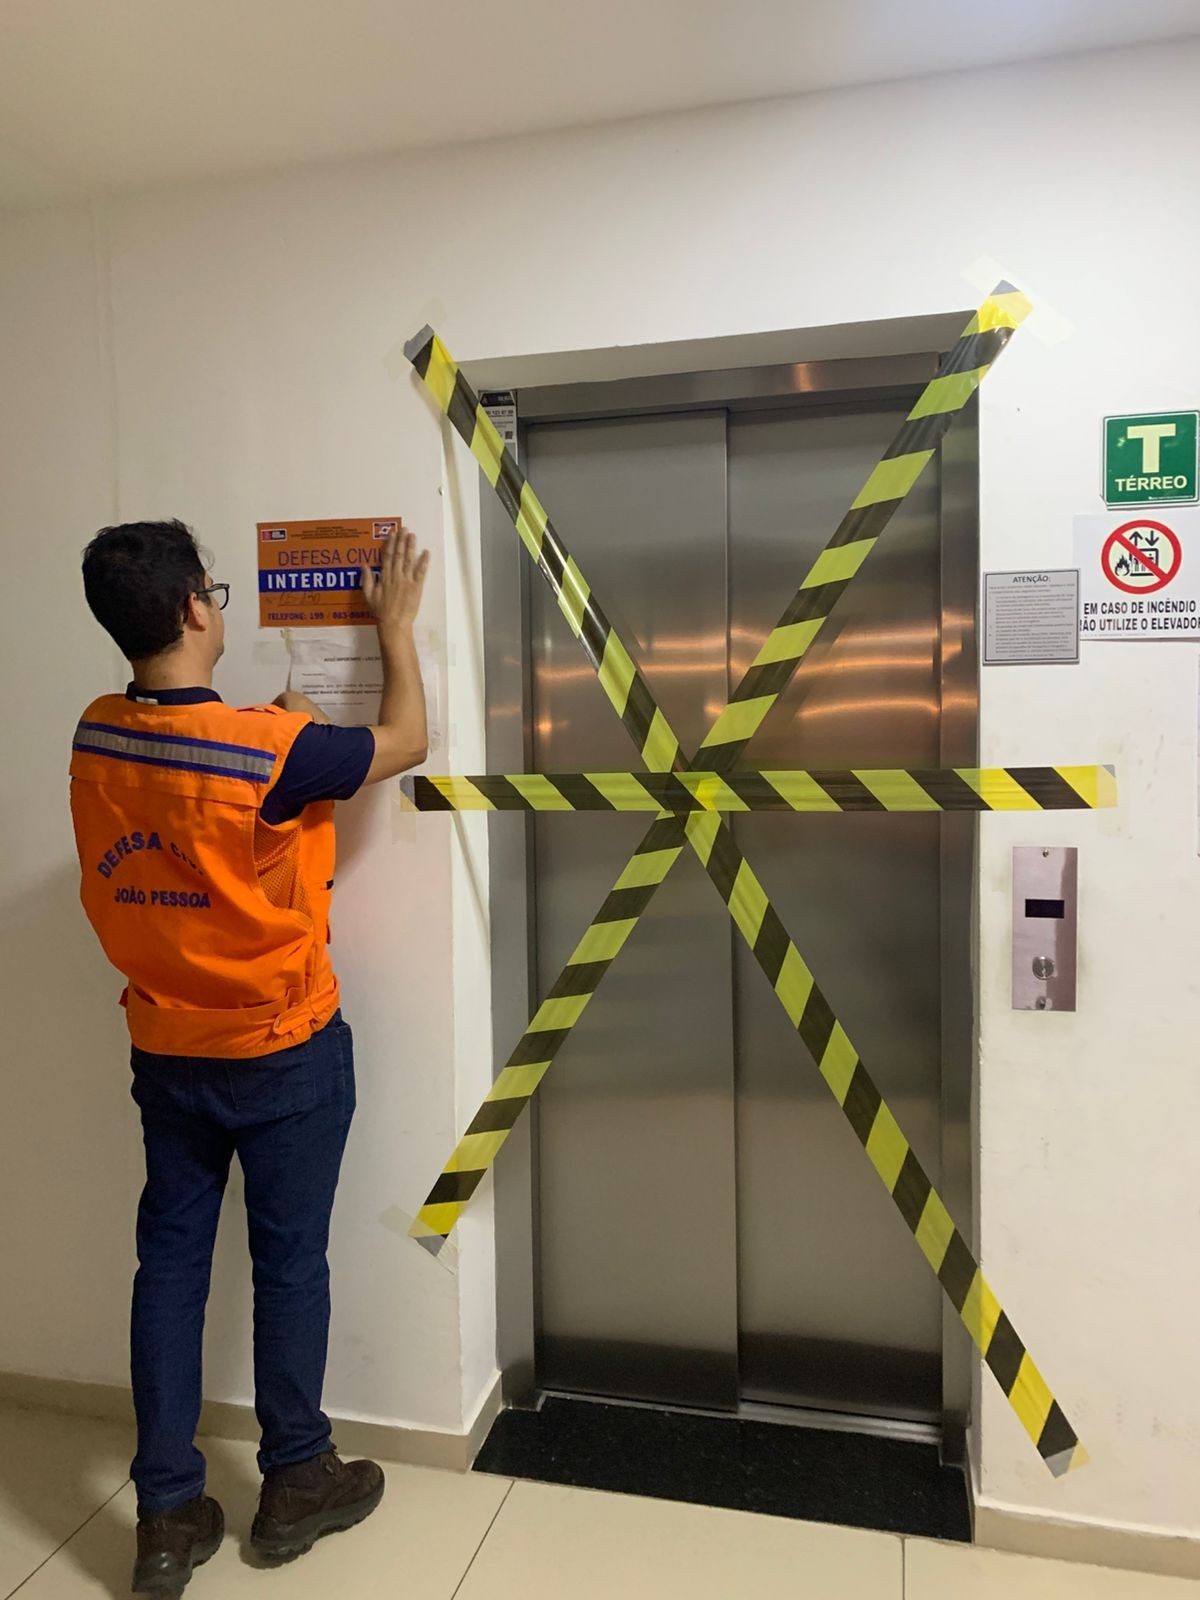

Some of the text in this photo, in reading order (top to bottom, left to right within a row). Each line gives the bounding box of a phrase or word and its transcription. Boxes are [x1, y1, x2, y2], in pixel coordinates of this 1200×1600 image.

[1127, 423, 1176, 473] T
[1115, 475, 1188, 492] TÉRREO
[278, 549, 342, 566] DEFESA
[1084, 598, 1196, 614] EM CASO DE INCÊNDIO
[1099, 618, 1138, 631] UTILIZE
[1141, 618, 1148, 630] O
[97, 831, 163, 879] DEFESA
[115, 886, 210, 909] JOÃO PESSOA
